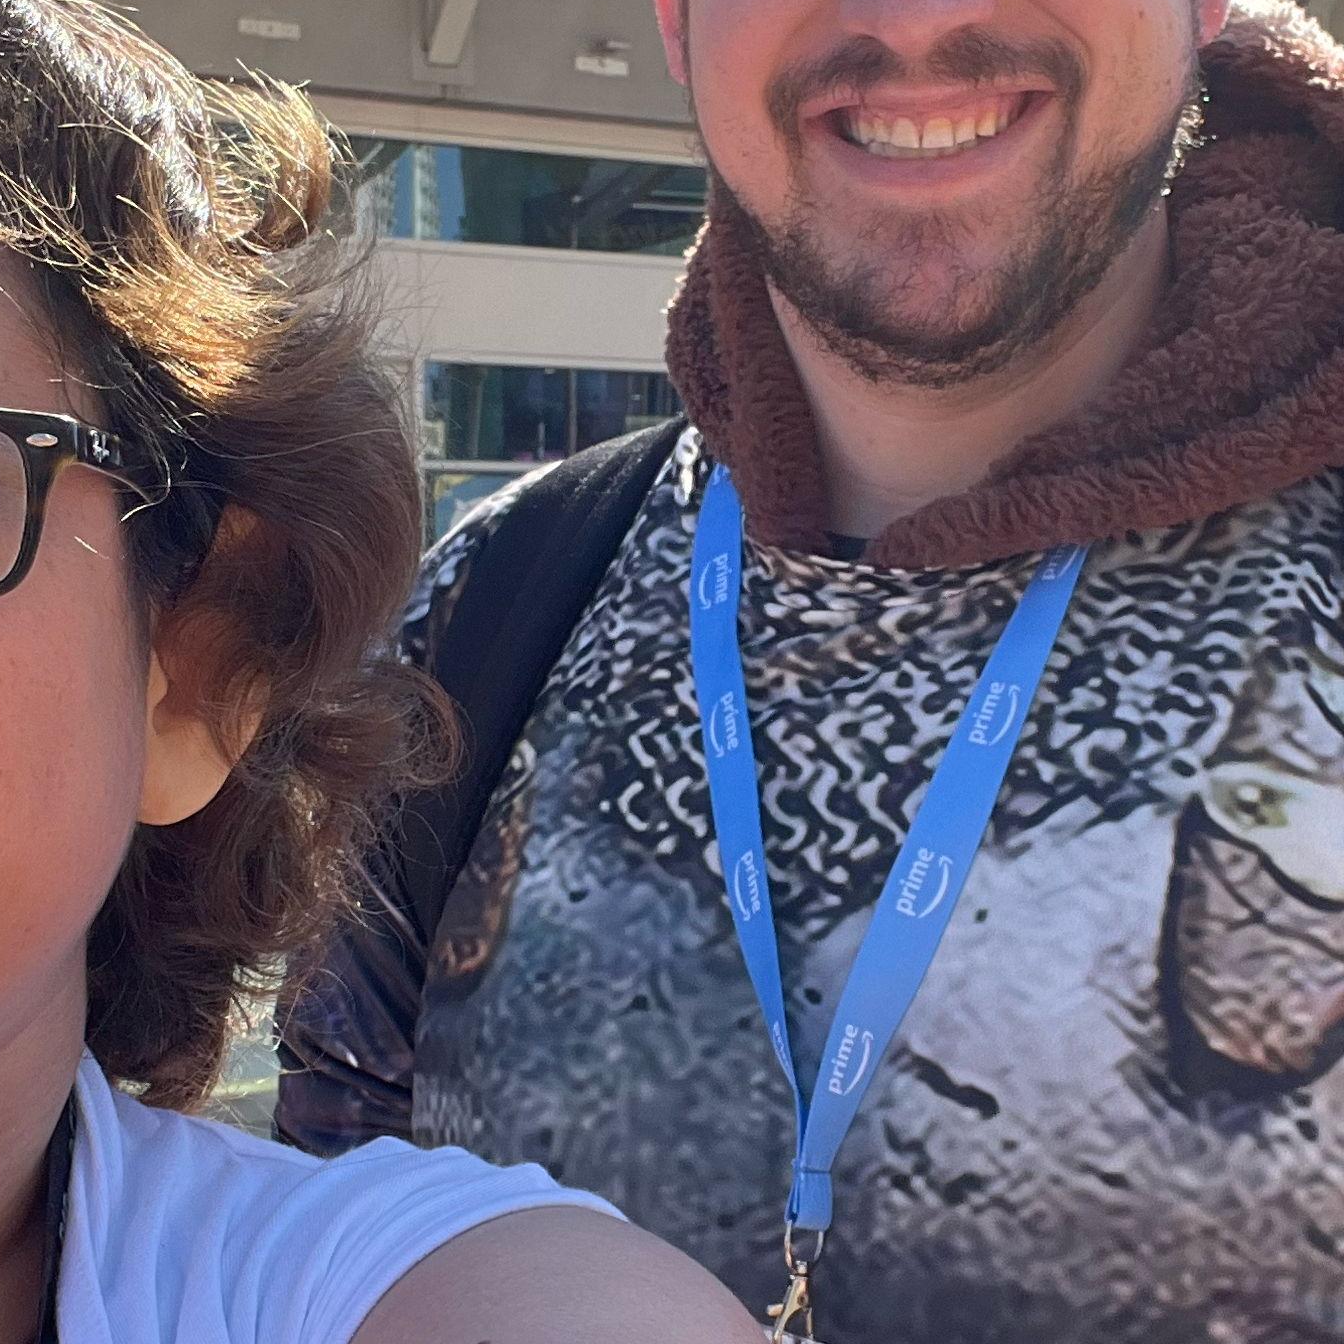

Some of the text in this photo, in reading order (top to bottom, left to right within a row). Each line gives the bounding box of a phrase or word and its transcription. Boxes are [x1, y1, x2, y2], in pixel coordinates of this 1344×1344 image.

[713, 552, 733, 605] prime
[720, 691, 740, 751] prime
[968, 681, 1005, 746] prime
[741, 849, 761, 915] prime
[896, 847, 935, 917] prime
[829, 1024, 858, 1095] prime
